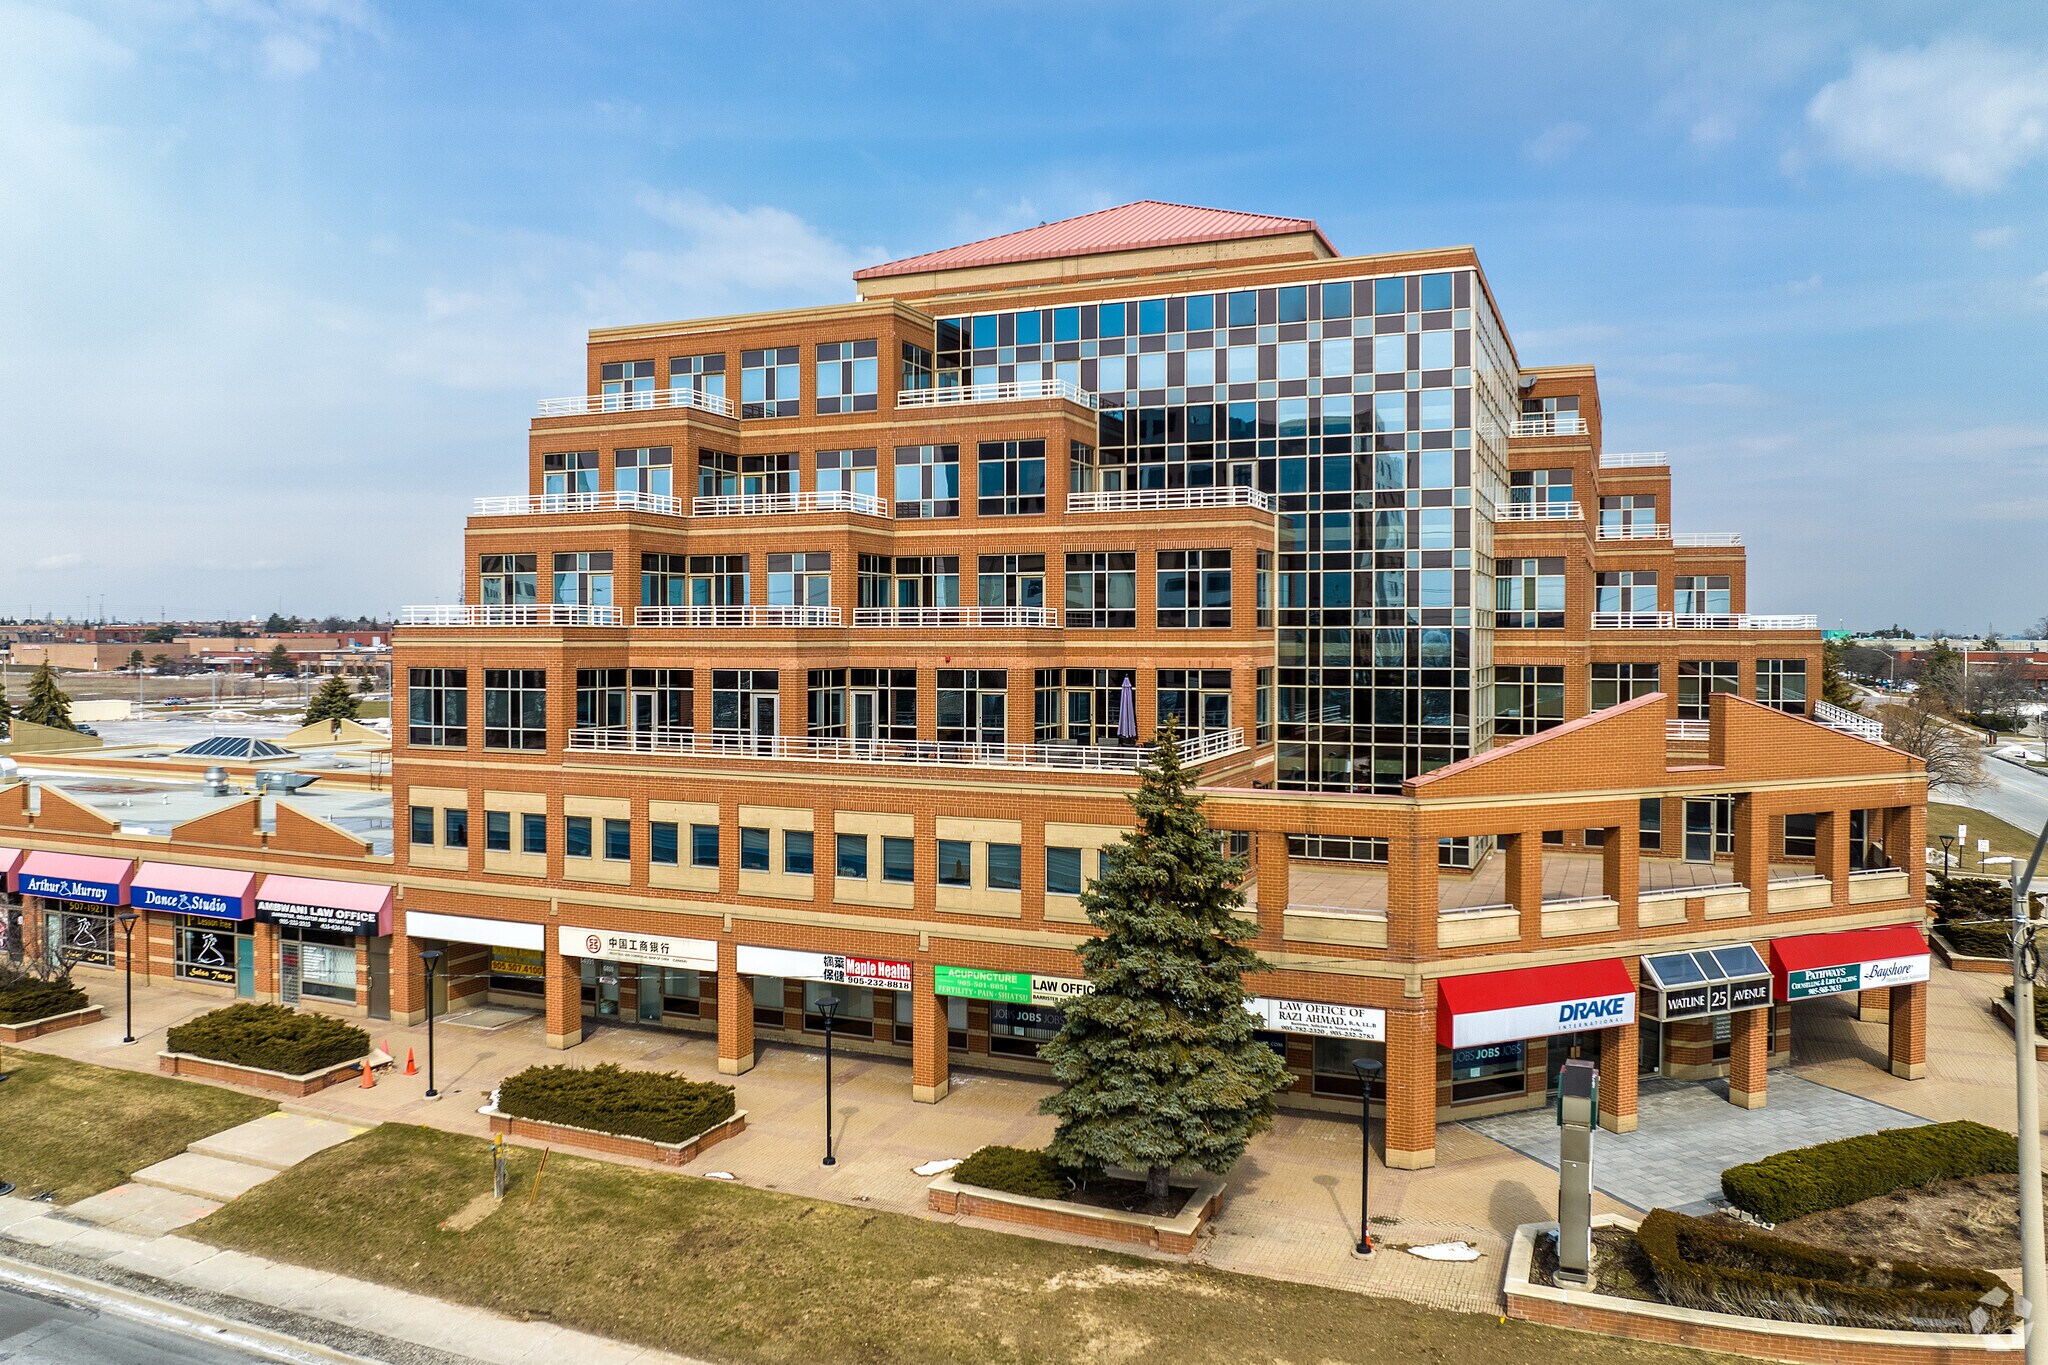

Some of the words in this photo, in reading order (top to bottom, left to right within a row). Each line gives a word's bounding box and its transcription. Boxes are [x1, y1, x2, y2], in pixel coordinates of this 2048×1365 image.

[27, 878, 60, 893] Arthur
[72, 882, 107, 901] Murray
[69, 902, 104, 913] 507-1921
[145, 890, 178, 907] Dance
[191, 896, 227, 912] Studio
[257, 901, 308, 915] AMBWANI
[309, 907, 334, 918] LAW
[335, 910, 376, 922] OFFICE
[197, 917, 219, 926] Lesson
[608, 937, 670, 955] 中国工商银行
[823, 968, 845, 983] 保健
[846, 959, 876, 977] Maple
[878, 961, 911, 980] Health
[948, 969, 1018, 984] ACUPUNCTURE
[1805, 967, 1847, 981] PATHWAYS
[1869, 962, 1911, 981] Bayshore
[847, 976, 910, 990] 905-232-8818
[1033, 979, 1057, 992] LAW
[1060, 982, 1096, 996] OFFIC
[938, 985, 973, 996] FERTILITY
[977, 989, 994, 998] PAIN
[998, 992, 1028, 1002] SHIATSU
[1668, 995, 1705, 1009] WATLINE
[1711, 991, 1727, 1007] 25
[1733, 987, 1767, 1001] AVENUE
[994, 1008, 1016, 1020] JOBS
[1016, 1011, 1042, 1023] JOBS
[1043, 1014, 1065, 1025] JOBS
[1279, 1001, 1303, 1011] LAW
[1306, 1004, 1346, 1016] OFFICE
[1349, 1008, 1365, 1018] OF
[1279, 1011, 1302, 1022] RAZI
[1559, 997, 1625, 1023] DRAKE
[1559, 1018, 1624, 1030] INTERNATIONAL
[1454, 1050, 1475, 1063] JOBS
[1476, 1047, 1500, 1060] JOBS
[1501, 1043, 1522, 1056] JOBS
